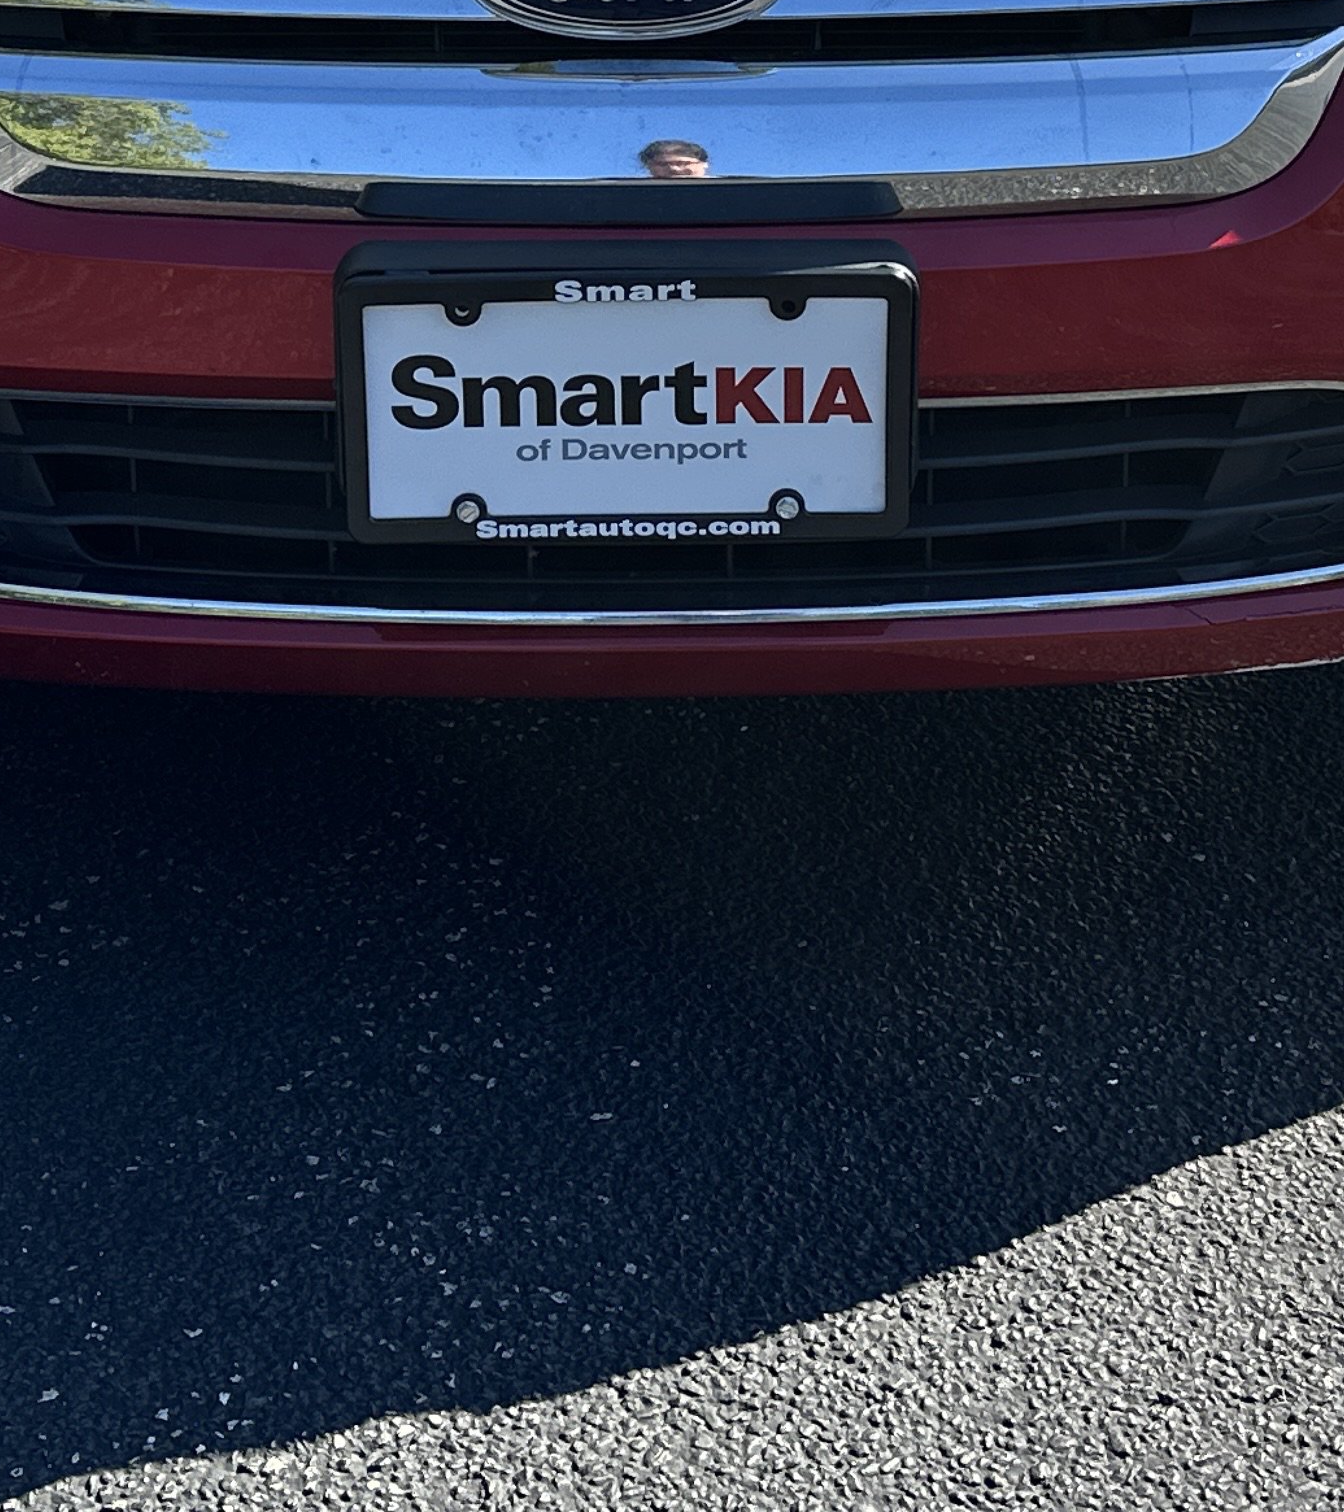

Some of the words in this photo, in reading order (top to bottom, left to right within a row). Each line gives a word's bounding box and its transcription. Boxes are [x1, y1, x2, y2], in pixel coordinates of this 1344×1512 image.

[554, 279, 698, 304] Smart
[391, 354, 873, 430] SmartKIA
[516, 438, 551, 462] of
[561, 438, 748, 465] Davenport
[476, 519, 781, 541] Smartautoqc.com
